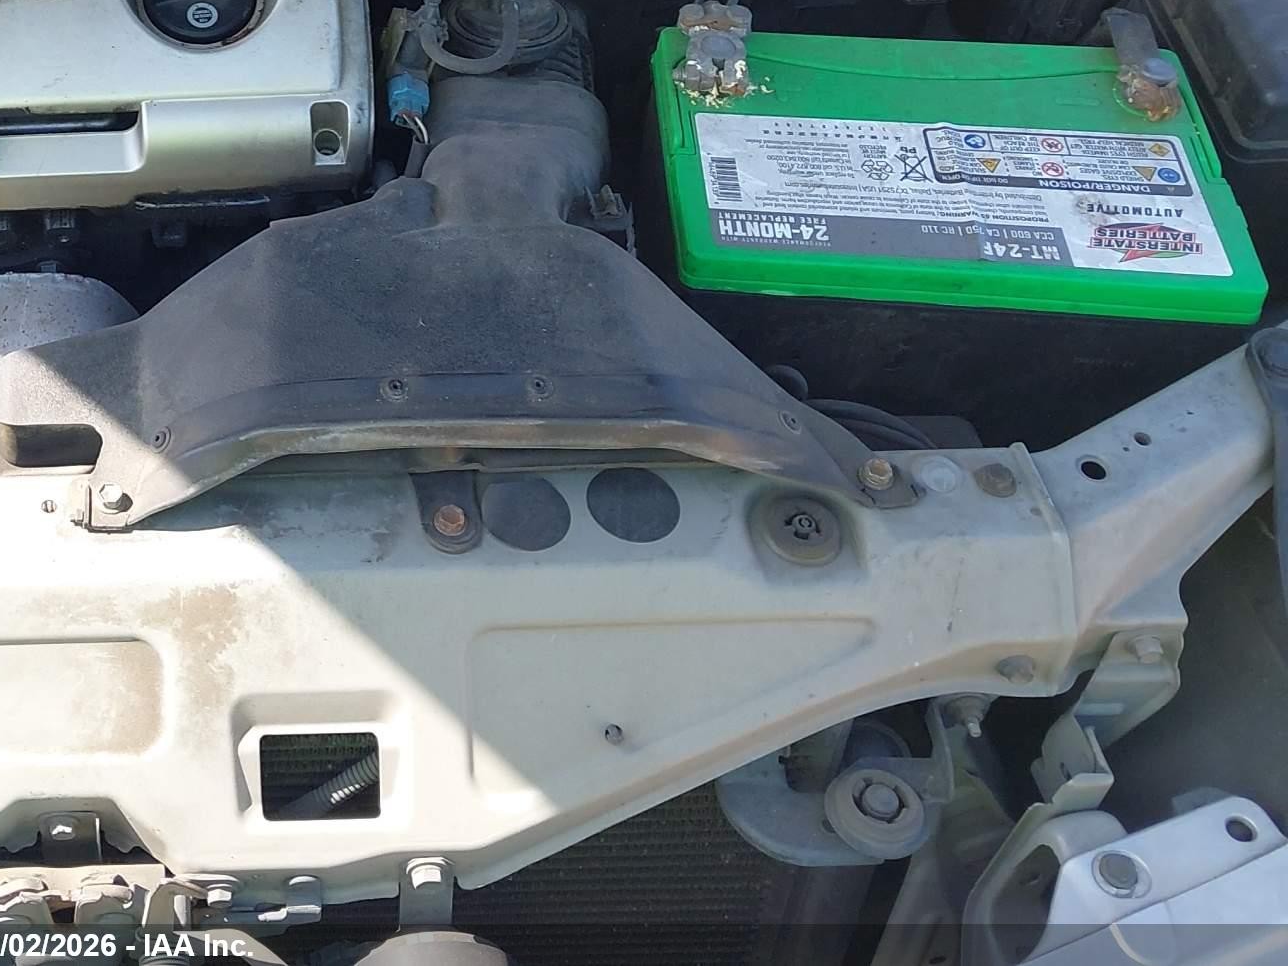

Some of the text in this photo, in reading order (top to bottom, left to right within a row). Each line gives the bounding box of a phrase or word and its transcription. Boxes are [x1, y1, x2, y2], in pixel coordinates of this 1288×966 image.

[900, 146, 917, 154] Pb
[1038, 180, 1151, 192] DANGER/POISON
[1086, 203, 1183, 218] AUTOMOTIVE
[718, 211, 826, 224] FREE REPLACEMENT
[718, 219, 830, 241] 24-MONTH
[921, 225, 939, 234] 110
[940, 225, 955, 235] RC
[986, 228, 1000, 238] CA
[1033, 230, 1054, 241] CCA
[1095, 227, 1194, 243] BATTERIES
[983, 241, 1060, 261] MT-24F
[1089, 237, 1202, 254] INTERSTATE
